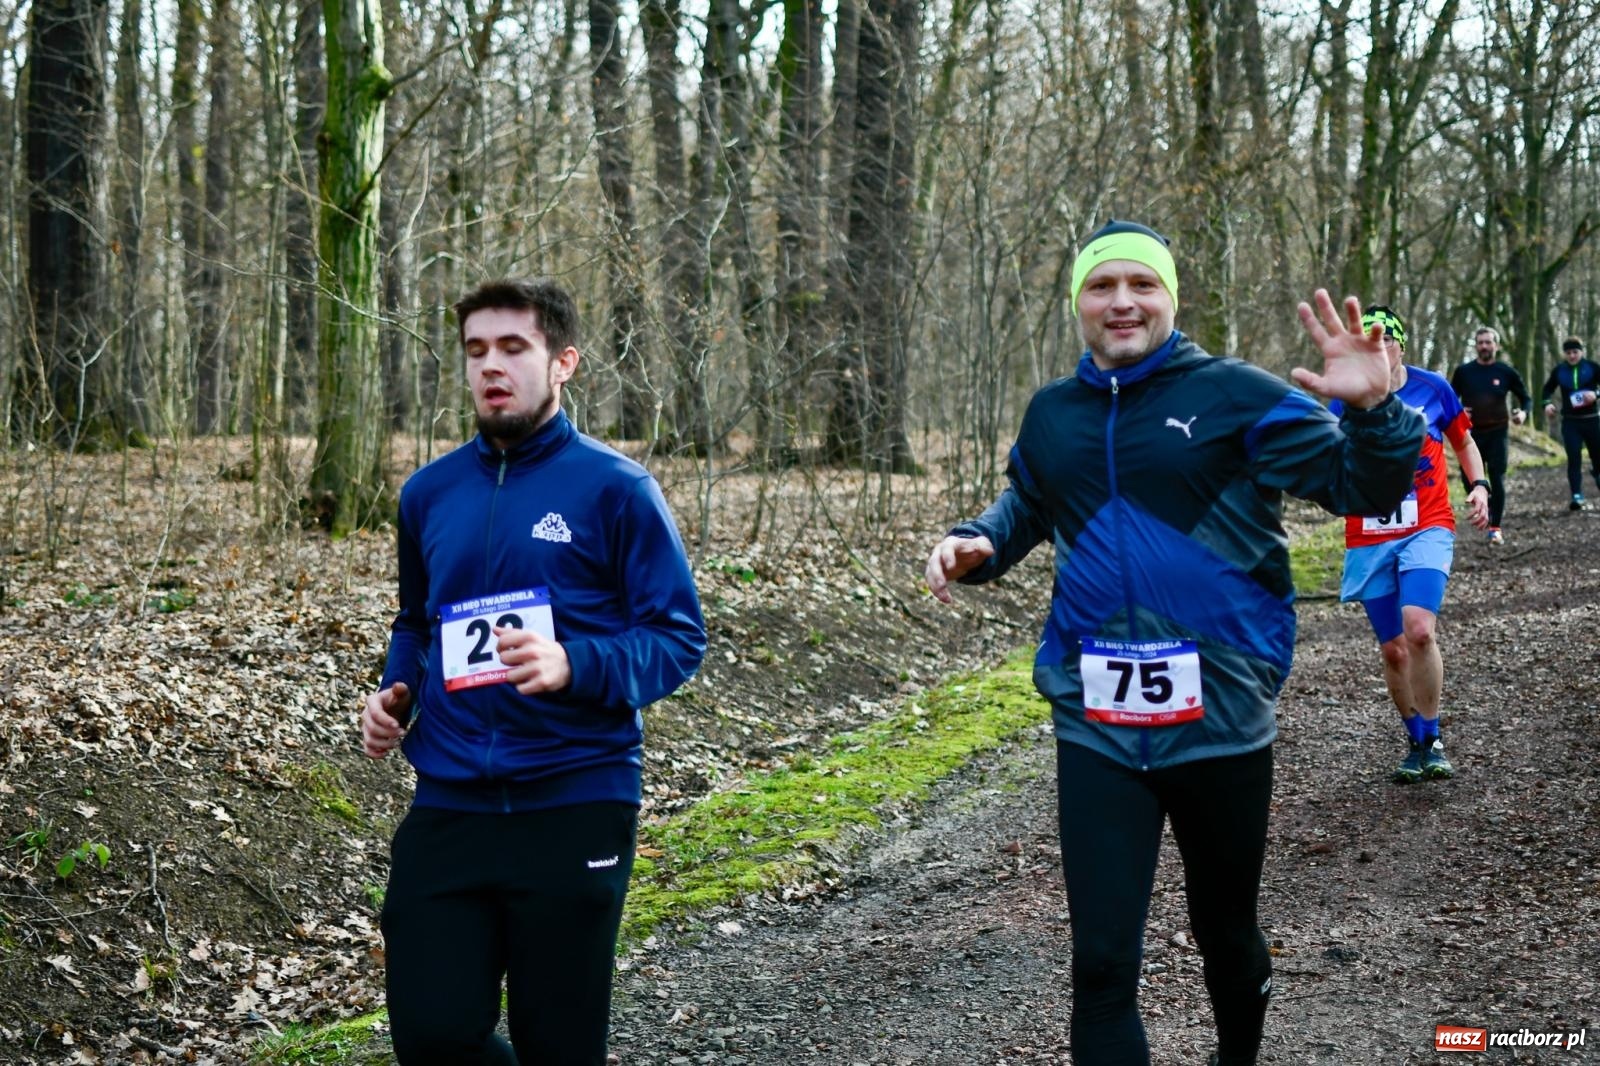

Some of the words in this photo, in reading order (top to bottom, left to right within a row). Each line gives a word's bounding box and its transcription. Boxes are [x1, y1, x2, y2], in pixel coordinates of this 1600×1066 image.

[463, 600, 480, 611] BIEG
[481, 590, 535, 606] TWARDZIELA
[1106, 641, 1125, 650] BIEG
[1126, 641, 1182, 651] TWARDZIELA
[1107, 660, 1173, 704] 75
